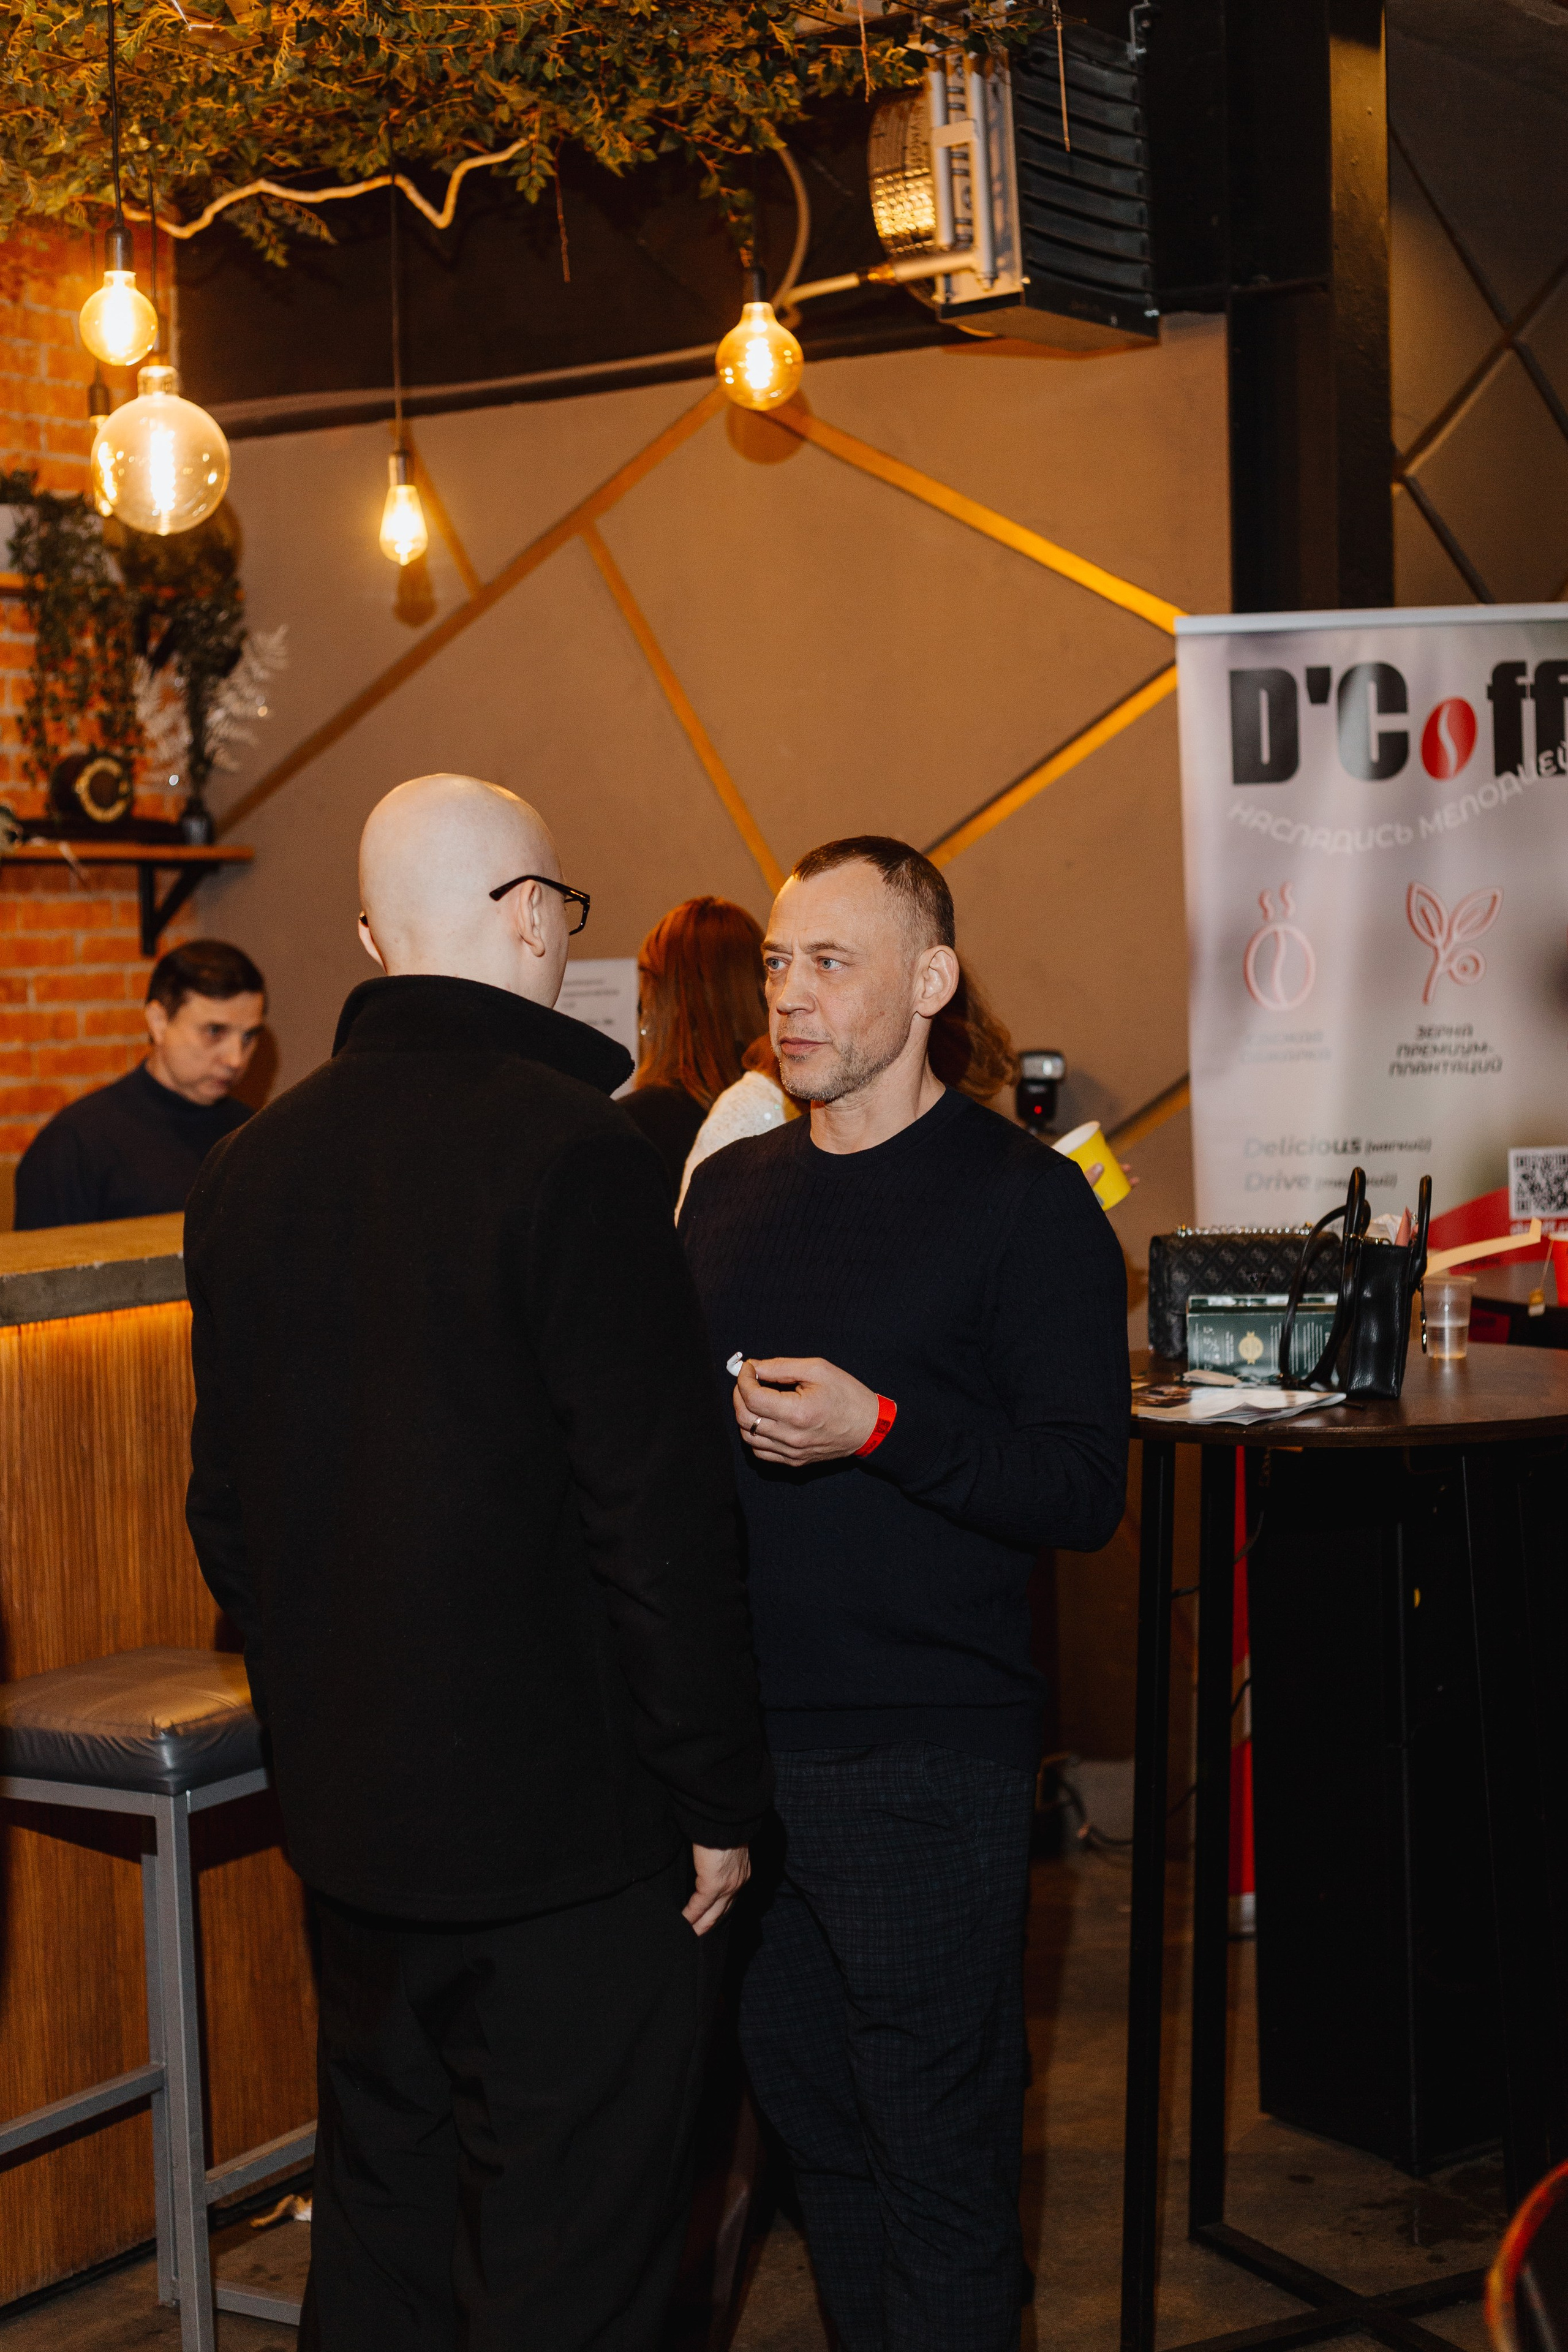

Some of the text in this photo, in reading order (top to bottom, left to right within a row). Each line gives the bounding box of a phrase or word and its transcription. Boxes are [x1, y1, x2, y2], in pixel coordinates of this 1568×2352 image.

[1227, 799, 1414, 855] НАСЛАДИСЬ
[1243, 1136, 1362, 1158] Delicious
[1244, 1170, 1311, 1192] Drive
